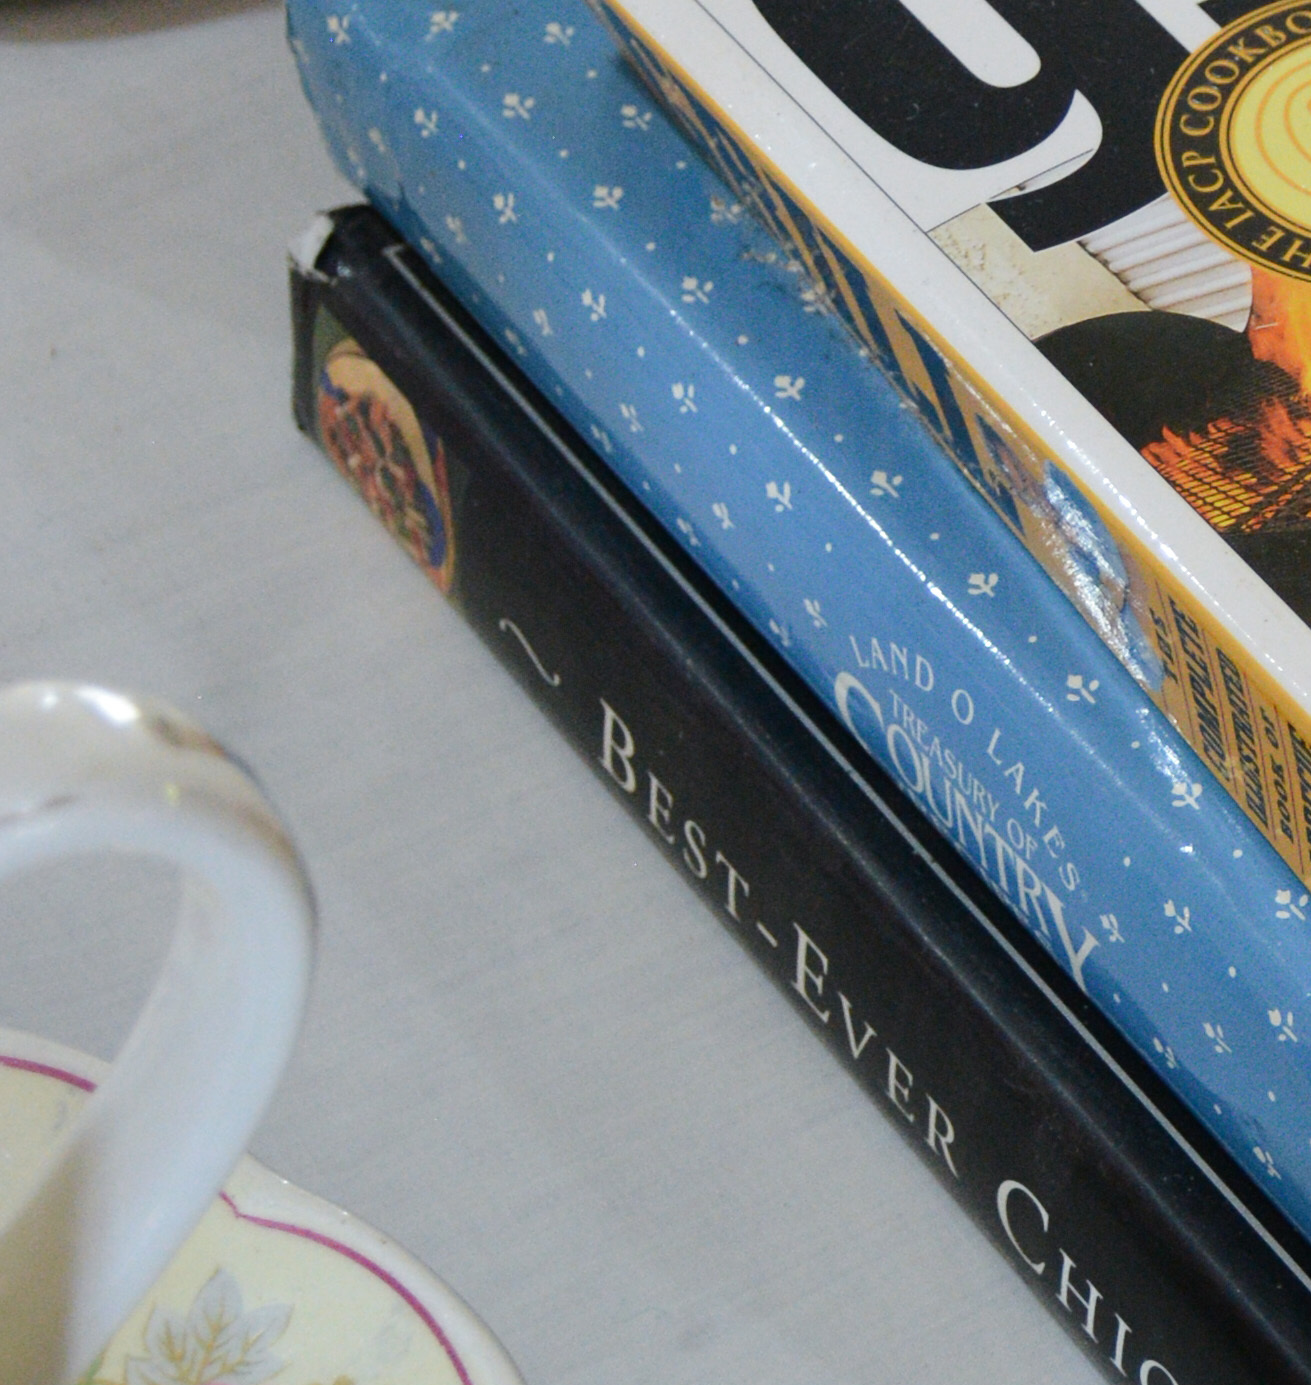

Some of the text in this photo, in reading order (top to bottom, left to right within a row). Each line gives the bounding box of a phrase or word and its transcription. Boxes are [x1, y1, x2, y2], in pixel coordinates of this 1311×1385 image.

[1180, 149, 1251, 232] IACP
[849, 634, 1080, 893] LAND O LAKES
[888, 688, 1039, 861] TREASURY OF
[1167, 594, 1231, 783] COMPLETE
[1215, 646, 1269, 831] ILLUSTRATED
[833, 670, 1100, 995] COUNTRY
[1269, 752, 1295, 845] BOOK
